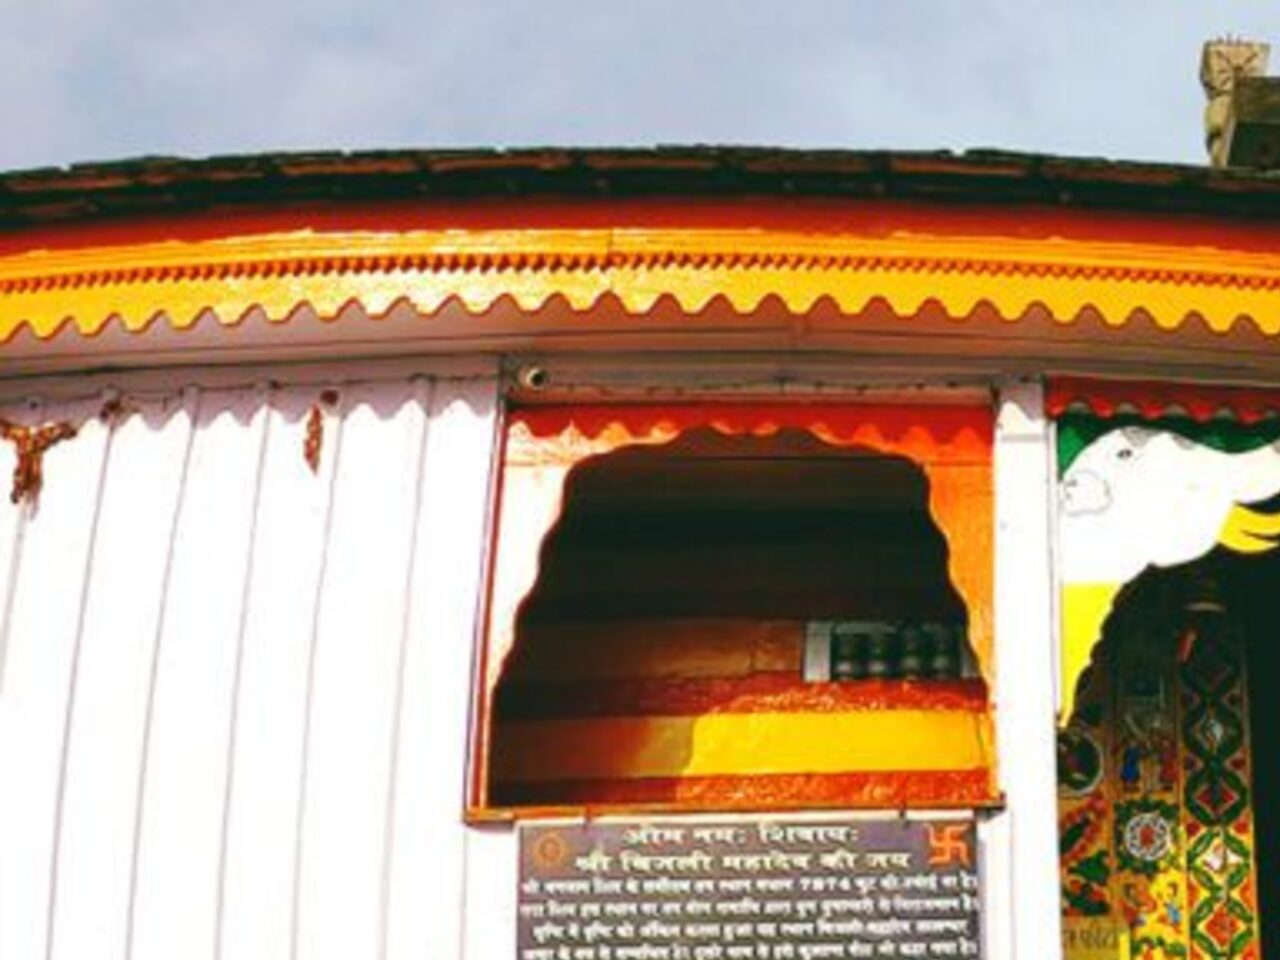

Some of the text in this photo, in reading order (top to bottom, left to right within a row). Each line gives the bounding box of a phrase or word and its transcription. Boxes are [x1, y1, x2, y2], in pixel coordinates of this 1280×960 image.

[619, 849, 711, 873] बिजली
[723, 849, 808, 872] महादेव
[820, 848, 856, 871] की
[865, 852, 912, 869] जय
